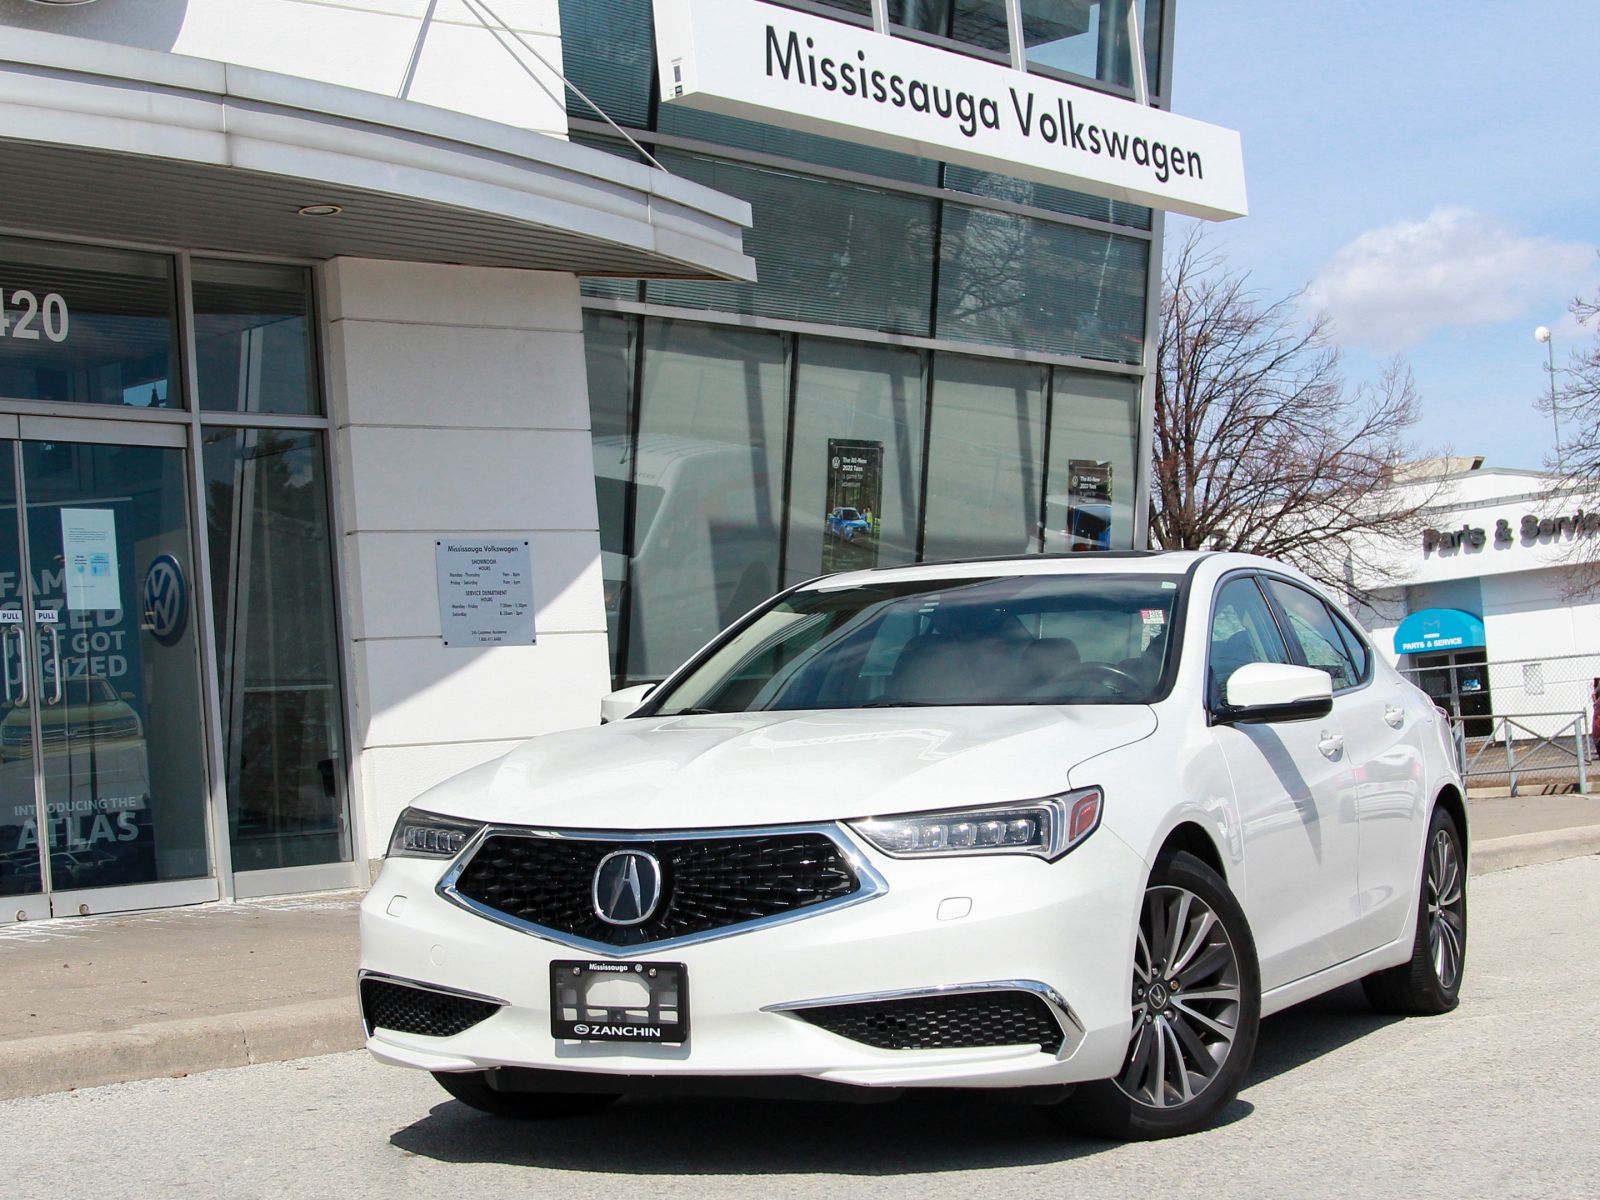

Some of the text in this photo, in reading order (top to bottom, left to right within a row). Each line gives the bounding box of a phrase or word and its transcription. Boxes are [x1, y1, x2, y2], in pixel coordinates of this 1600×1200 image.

[764, 25, 1204, 183] Mississauga Volkswagen
[1423, 508, 1600, 553] Parts & Servic
[448, 545, 518, 553] Mississauga Volkswagen
[38, 612, 56, 620] PULL
[72, 630, 126, 654] GOT
[1402, 641, 1425, 650] PARTS
[1434, 637, 1463, 647] SERVICE
[14, 796, 136, 817] INTODUCING THE
[17, 811, 139, 850] ATLAS
[588, 963, 628, 972] Mississauga
[591, 1025, 661, 1037] ZANCHIN
